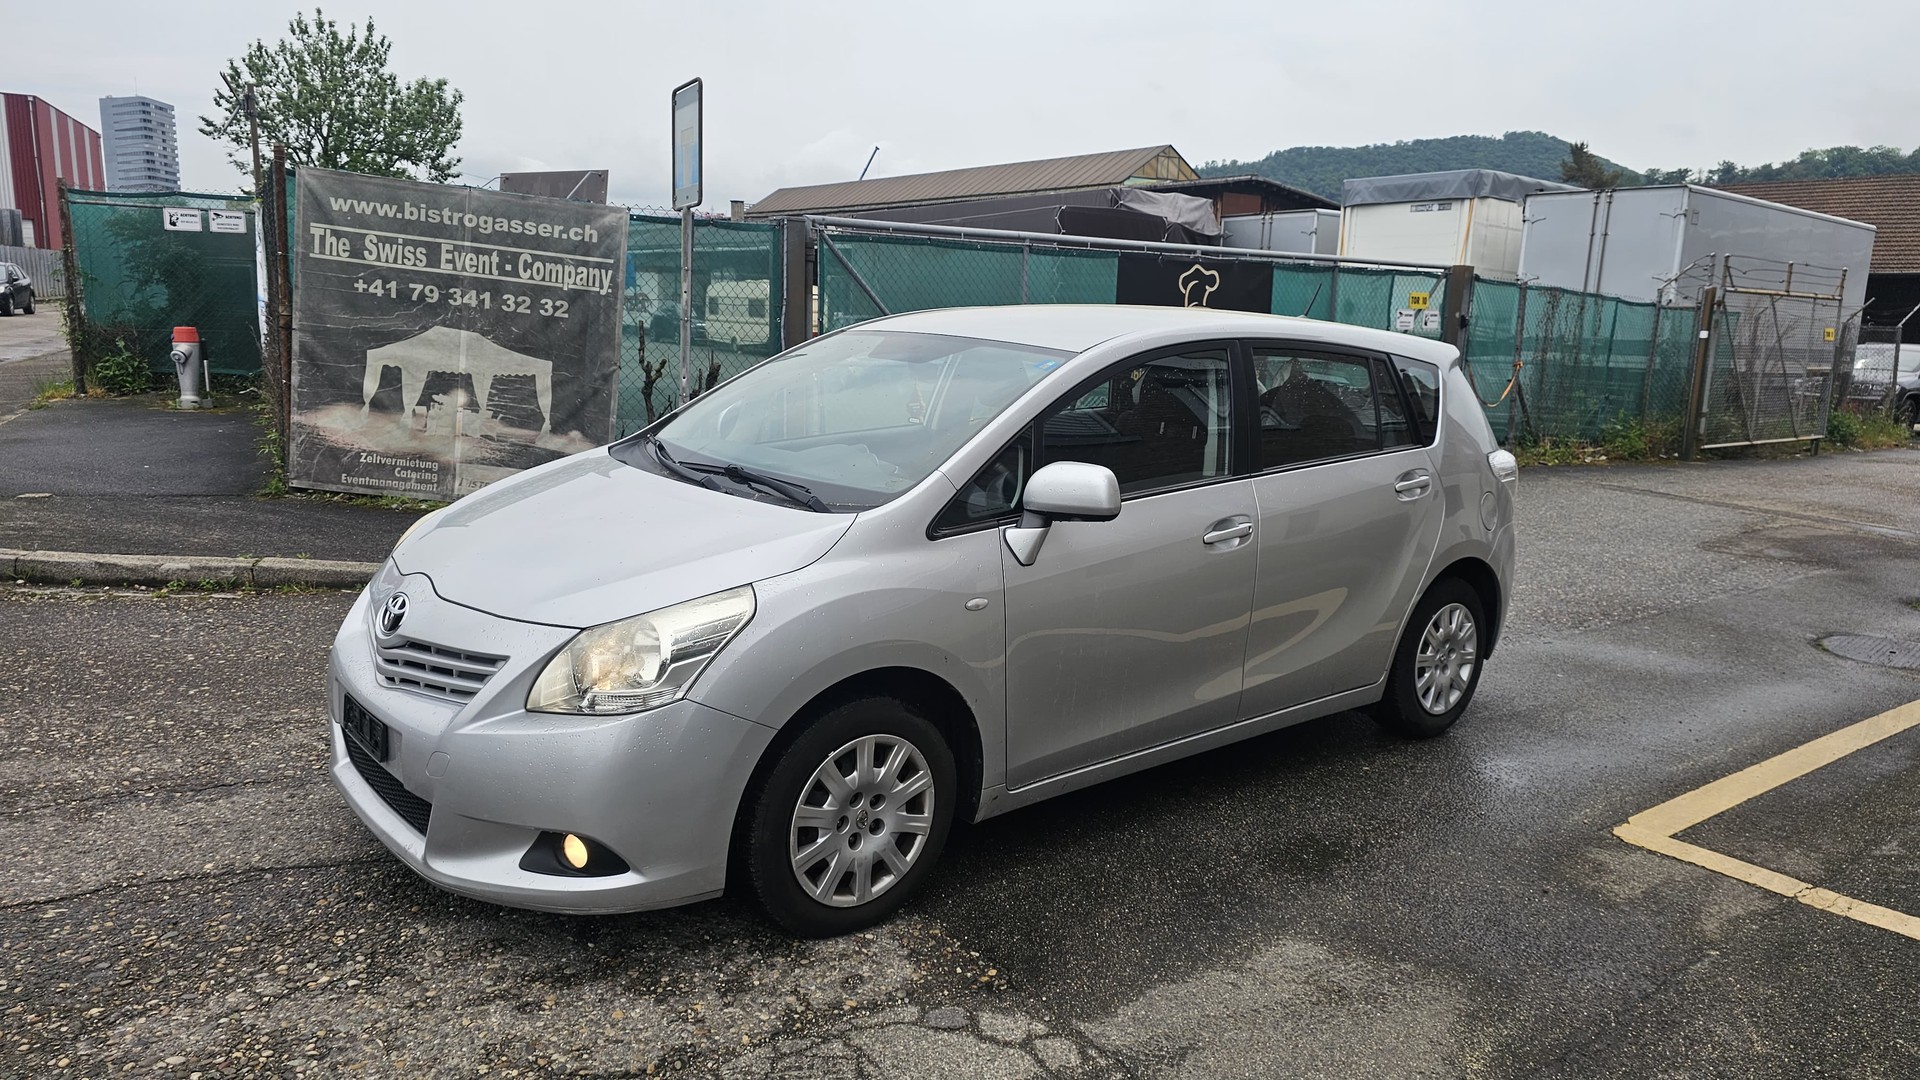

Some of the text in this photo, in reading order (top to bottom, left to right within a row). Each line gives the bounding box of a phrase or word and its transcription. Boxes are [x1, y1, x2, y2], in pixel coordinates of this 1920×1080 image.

[329, 197, 598, 243] www.bistrogasser.ch
[310, 227, 350, 258] The
[364, 234, 427, 267] Swiss
[440, 243, 499, 276] Event
[518, 253, 613, 295] Company
[354, 279, 569, 318] +41 79 341 32 32
[360, 453, 438, 471] Zeltvermietung
[395, 468, 438, 482] Catering
[341, 474, 437, 492] Eventmanagement
